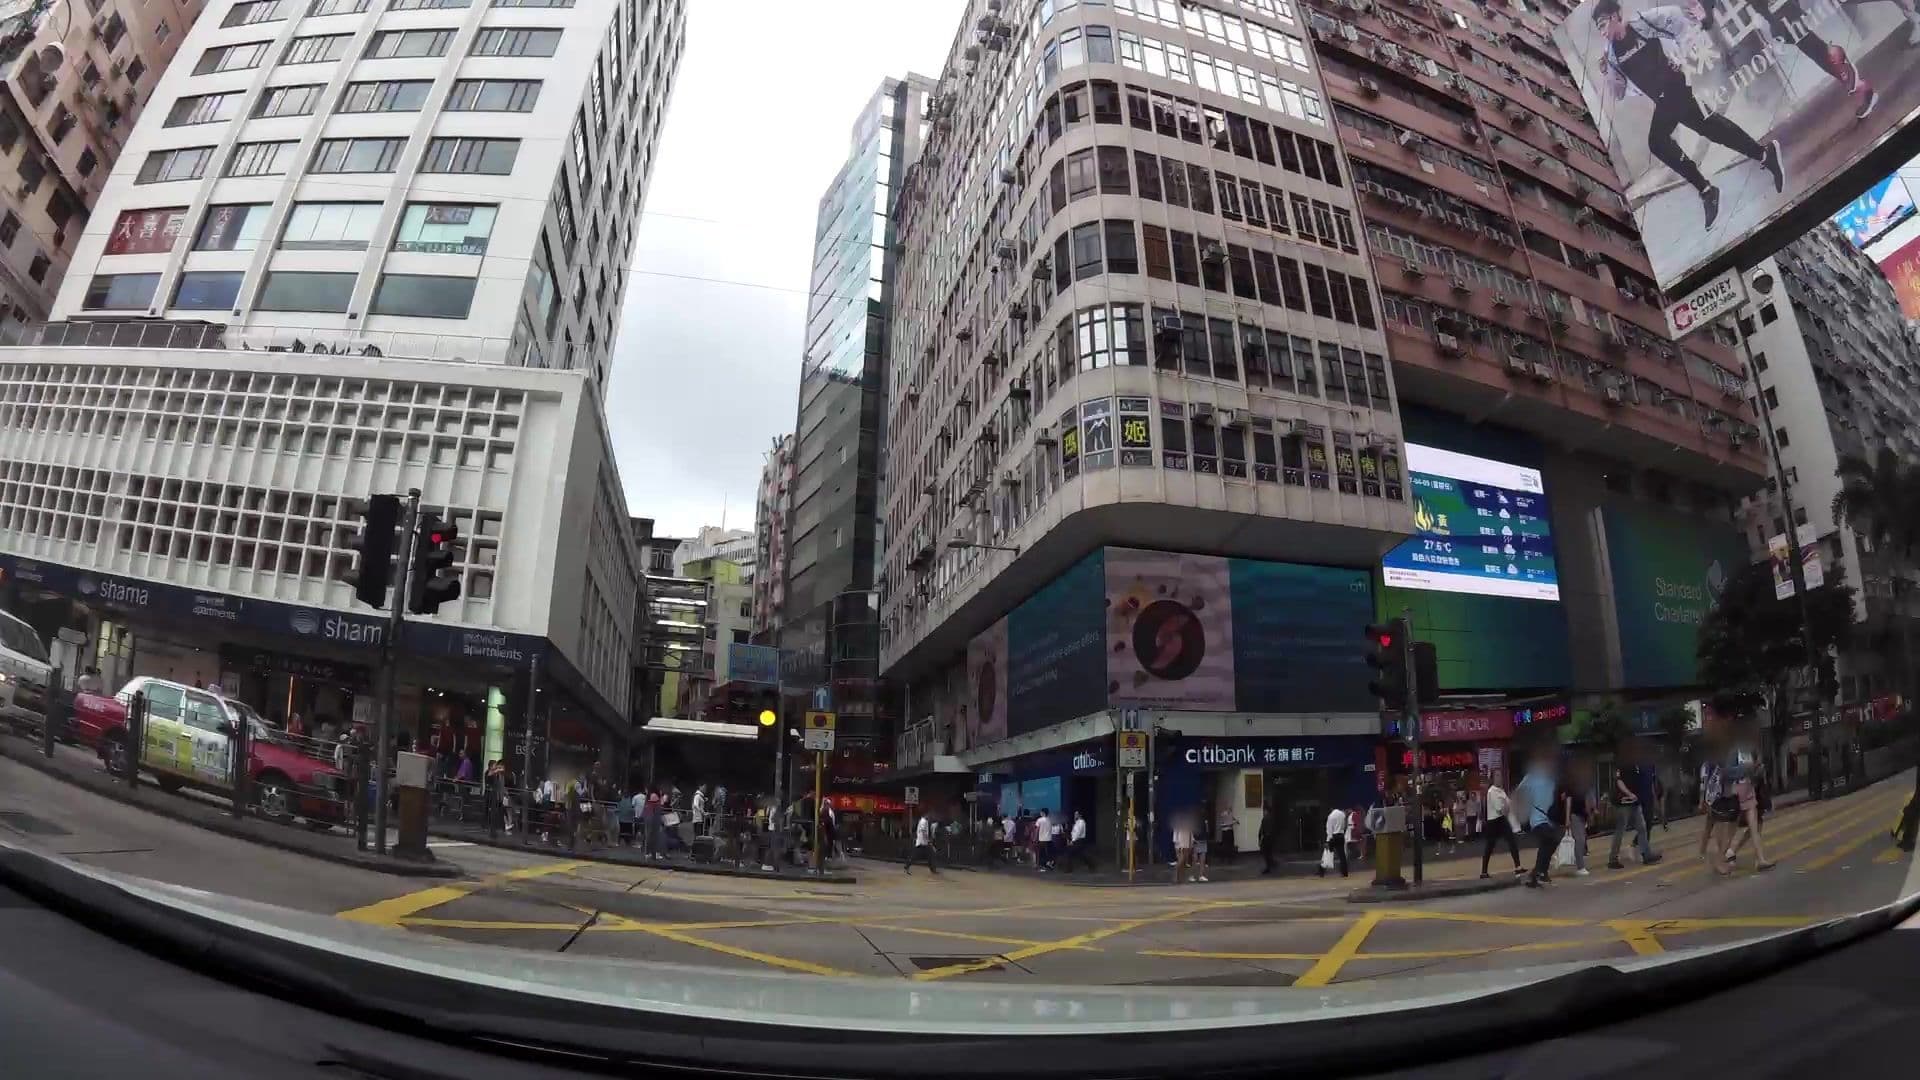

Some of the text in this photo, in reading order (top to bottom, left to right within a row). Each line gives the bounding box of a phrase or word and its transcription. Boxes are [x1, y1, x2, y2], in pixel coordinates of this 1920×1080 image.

[1689, 277, 1732, 311] CONVEY
[99, 578, 150, 606] shama
[1185, 744, 1316, 764] citibank 花旗銀行
